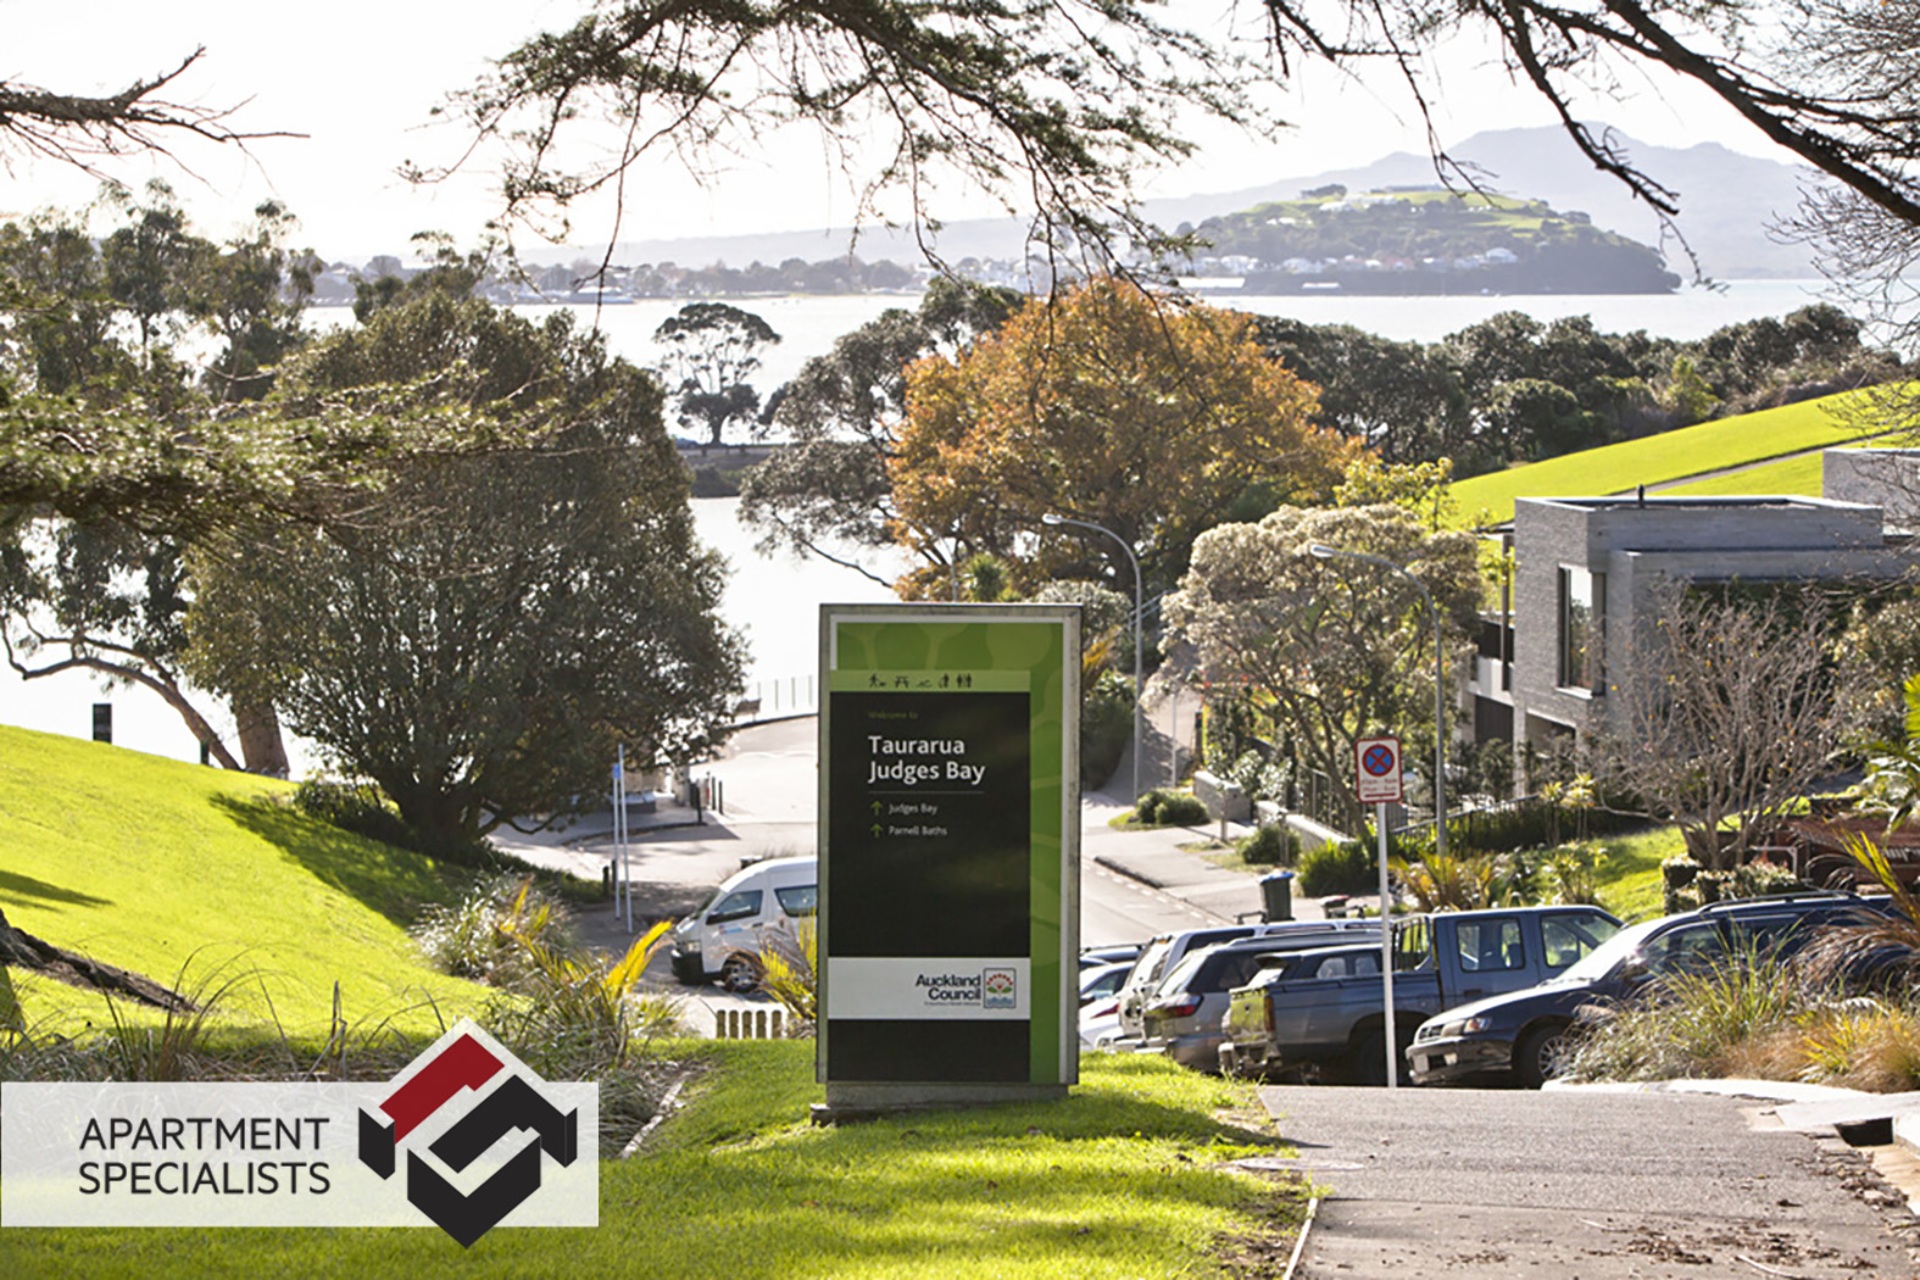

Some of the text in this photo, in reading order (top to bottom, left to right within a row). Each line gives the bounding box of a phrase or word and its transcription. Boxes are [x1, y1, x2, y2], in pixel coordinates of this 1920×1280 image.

[868, 735, 965, 754] Taurarua
[868, 760, 986, 785] Judges Bay
[888, 803, 938, 815] Judges Bay
[888, 825, 947, 836] Parnell Baths
[915, 974, 981, 987] Auckland
[928, 987, 981, 1001] Council
